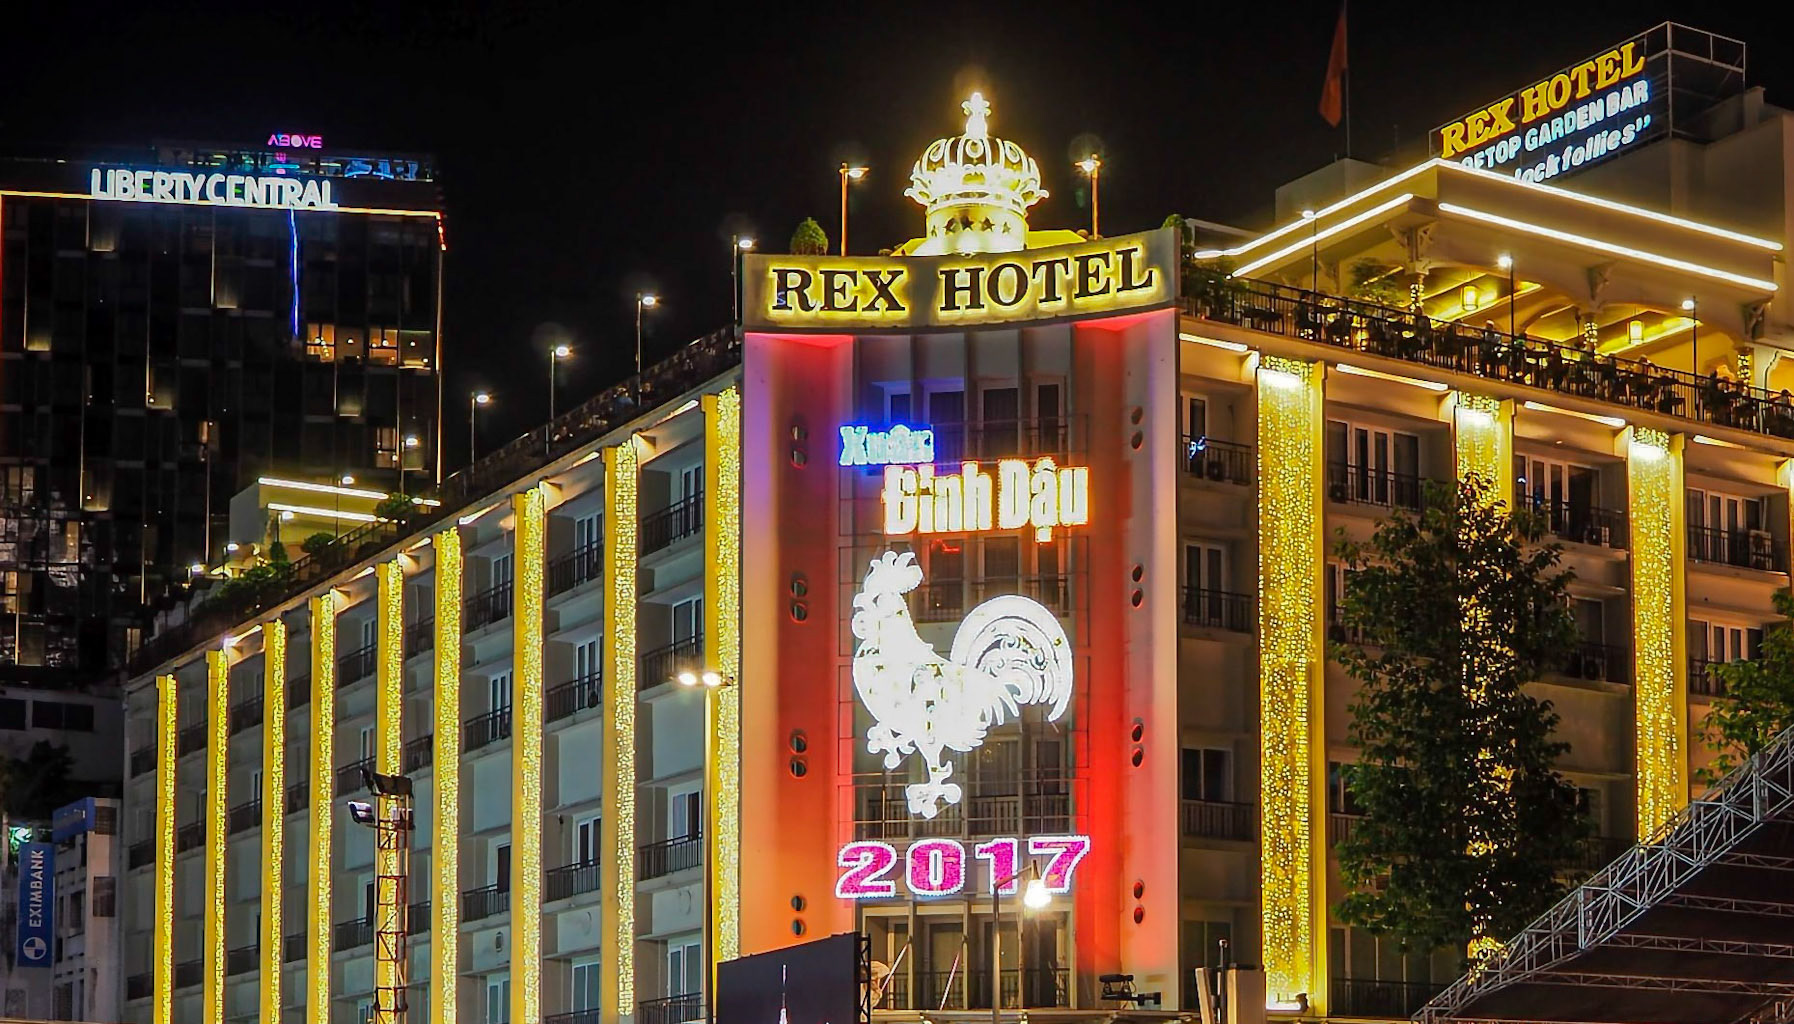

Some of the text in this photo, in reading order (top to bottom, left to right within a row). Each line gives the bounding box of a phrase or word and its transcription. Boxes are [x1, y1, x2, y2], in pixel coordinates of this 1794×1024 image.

[1441, 42, 1646, 158] REX HOTEL
[1459, 79, 1649, 168] OFTOP GARDEN BAR
[771, 246, 1154, 313] REX HOTEL
[997, 456, 1089, 544] Dậu
[29, 850, 44, 928] EXIMBANK
[835, 835, 1091, 899] 2017
